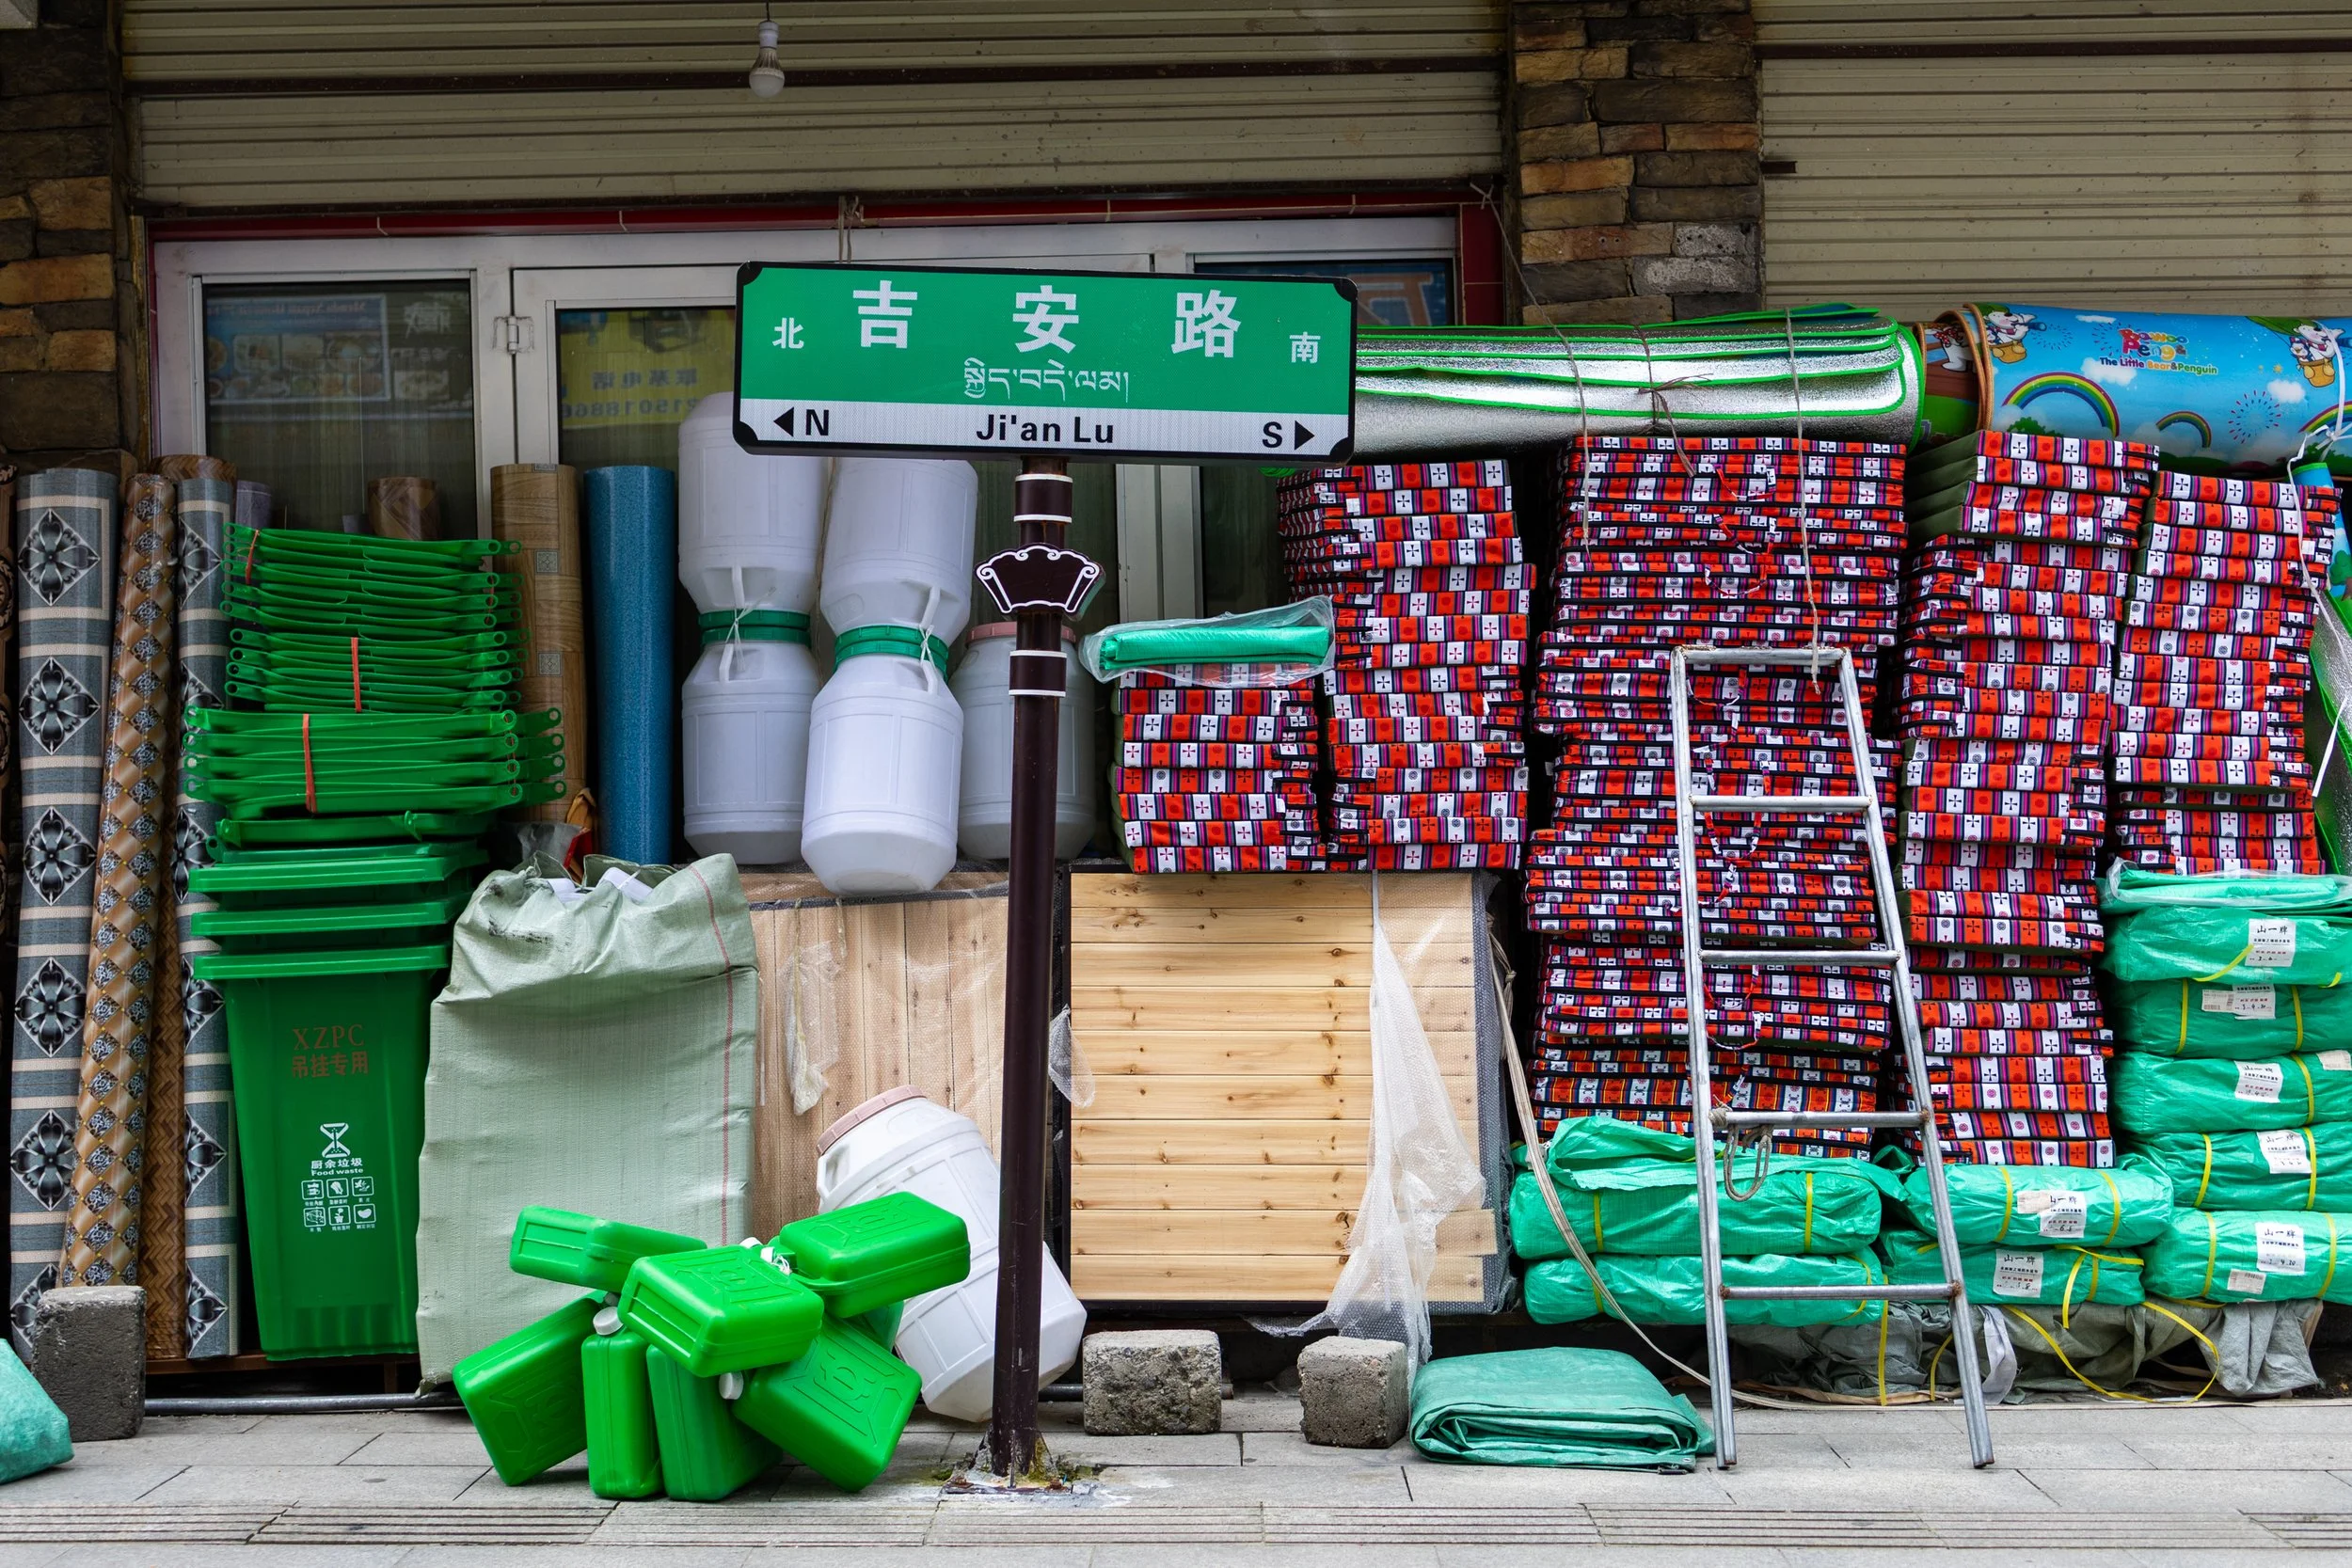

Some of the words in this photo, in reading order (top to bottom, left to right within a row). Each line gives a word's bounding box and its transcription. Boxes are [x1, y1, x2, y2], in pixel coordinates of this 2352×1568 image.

[852, 279, 1242, 359] 吉安路
[772, 317, 804, 349] 北
[1289, 331, 1321, 364] 南
[2100, 356, 2118, 366] The
[2120, 357, 2144, 369] Little
[805, 409, 830, 436] N
[976, 414, 1061, 442] Ji'an
[1073, 416, 1114, 444] Lu
[1262, 421, 1283, 449] S
[292, 1024, 365, 1051] XZPC
[291, 1052, 369, 1078] 吊挂专用
[311, 1158, 363, 1169] 厨余垃圾
